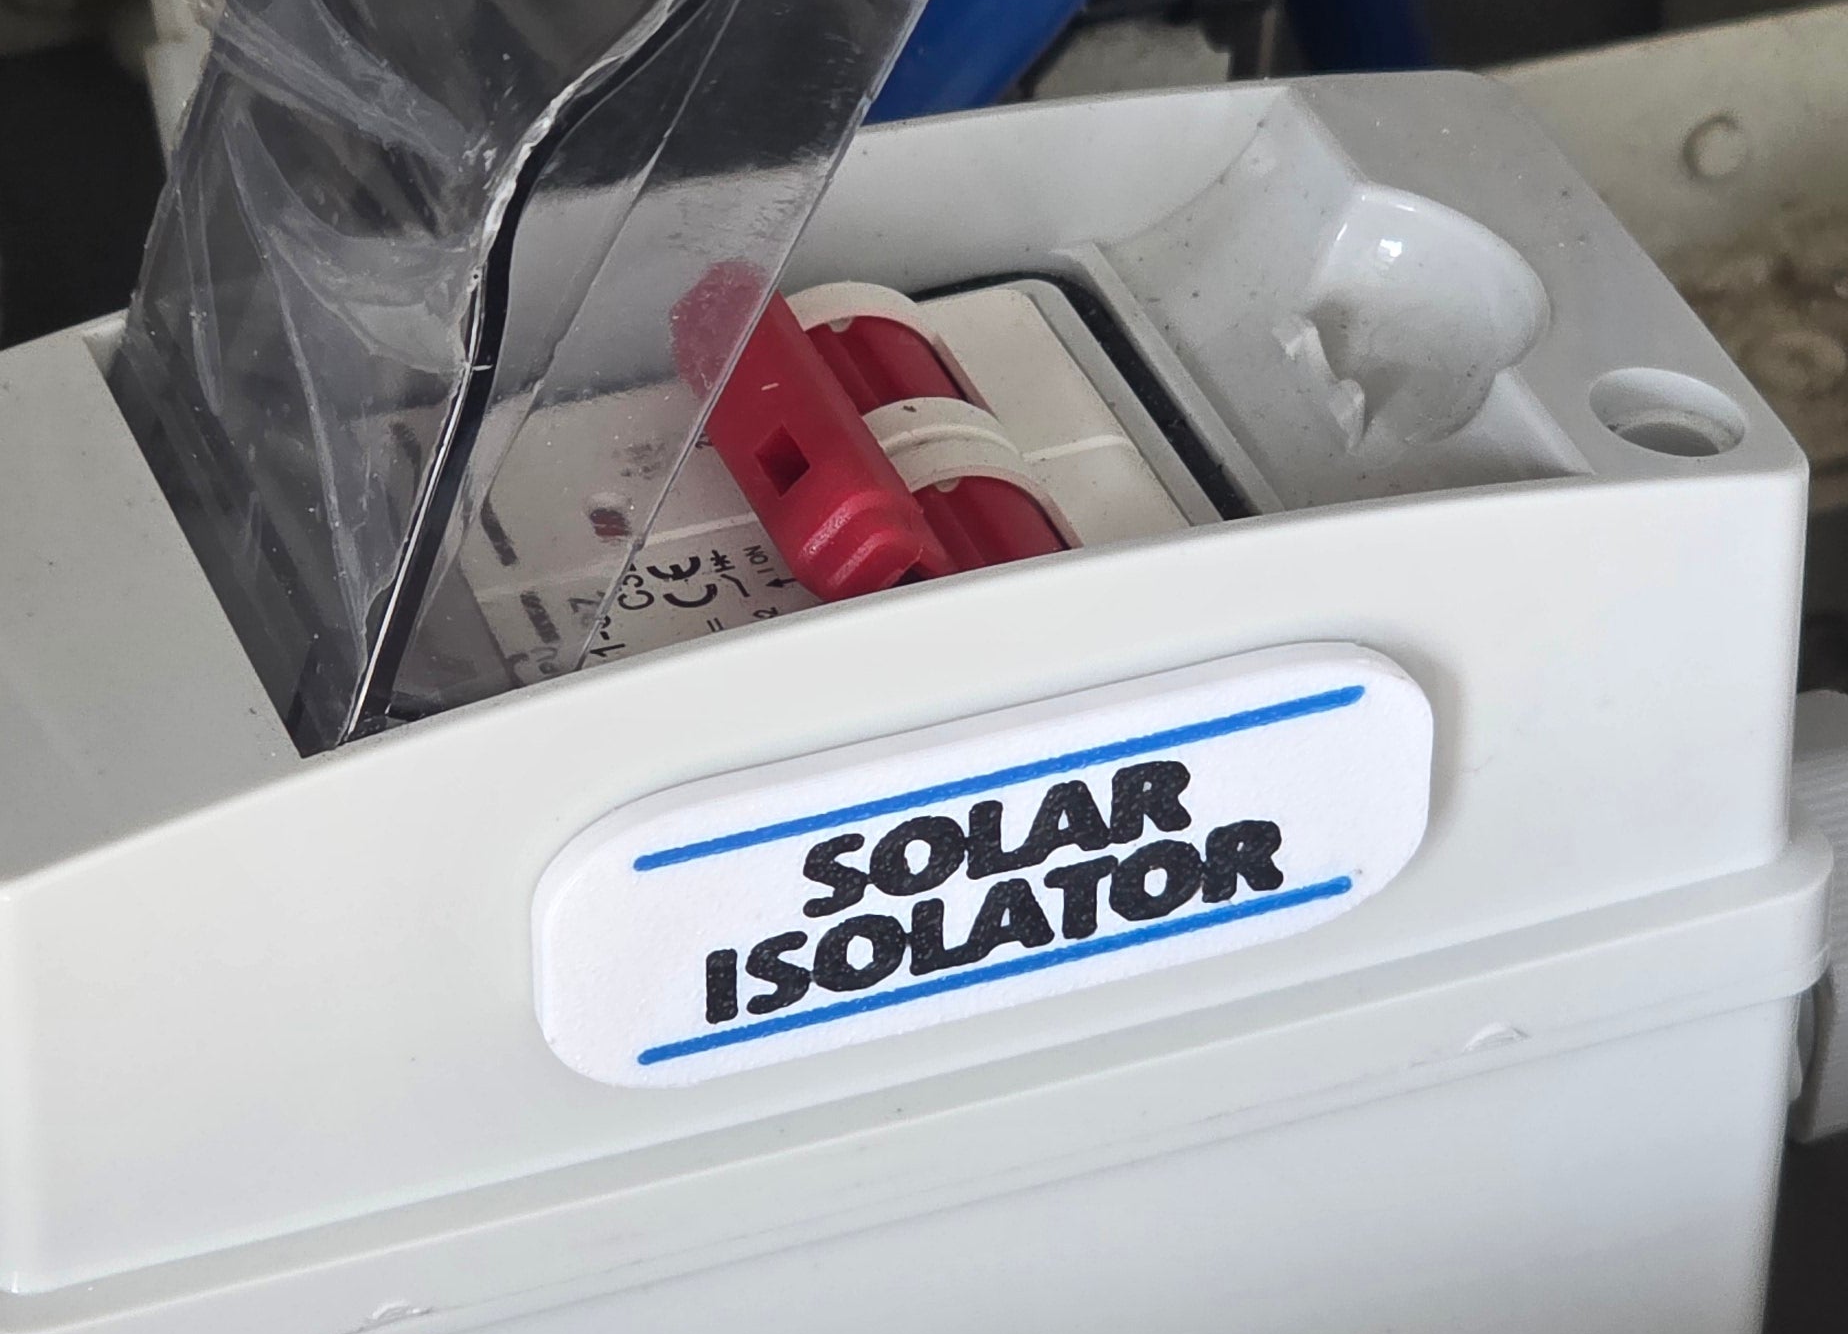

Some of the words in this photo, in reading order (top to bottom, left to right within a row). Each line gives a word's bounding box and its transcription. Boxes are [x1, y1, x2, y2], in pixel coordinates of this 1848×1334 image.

[646, 555, 718, 608] CE
[803, 760, 1192, 918] SOLAR
[705, 819, 1284, 1024] ISOLATOR
